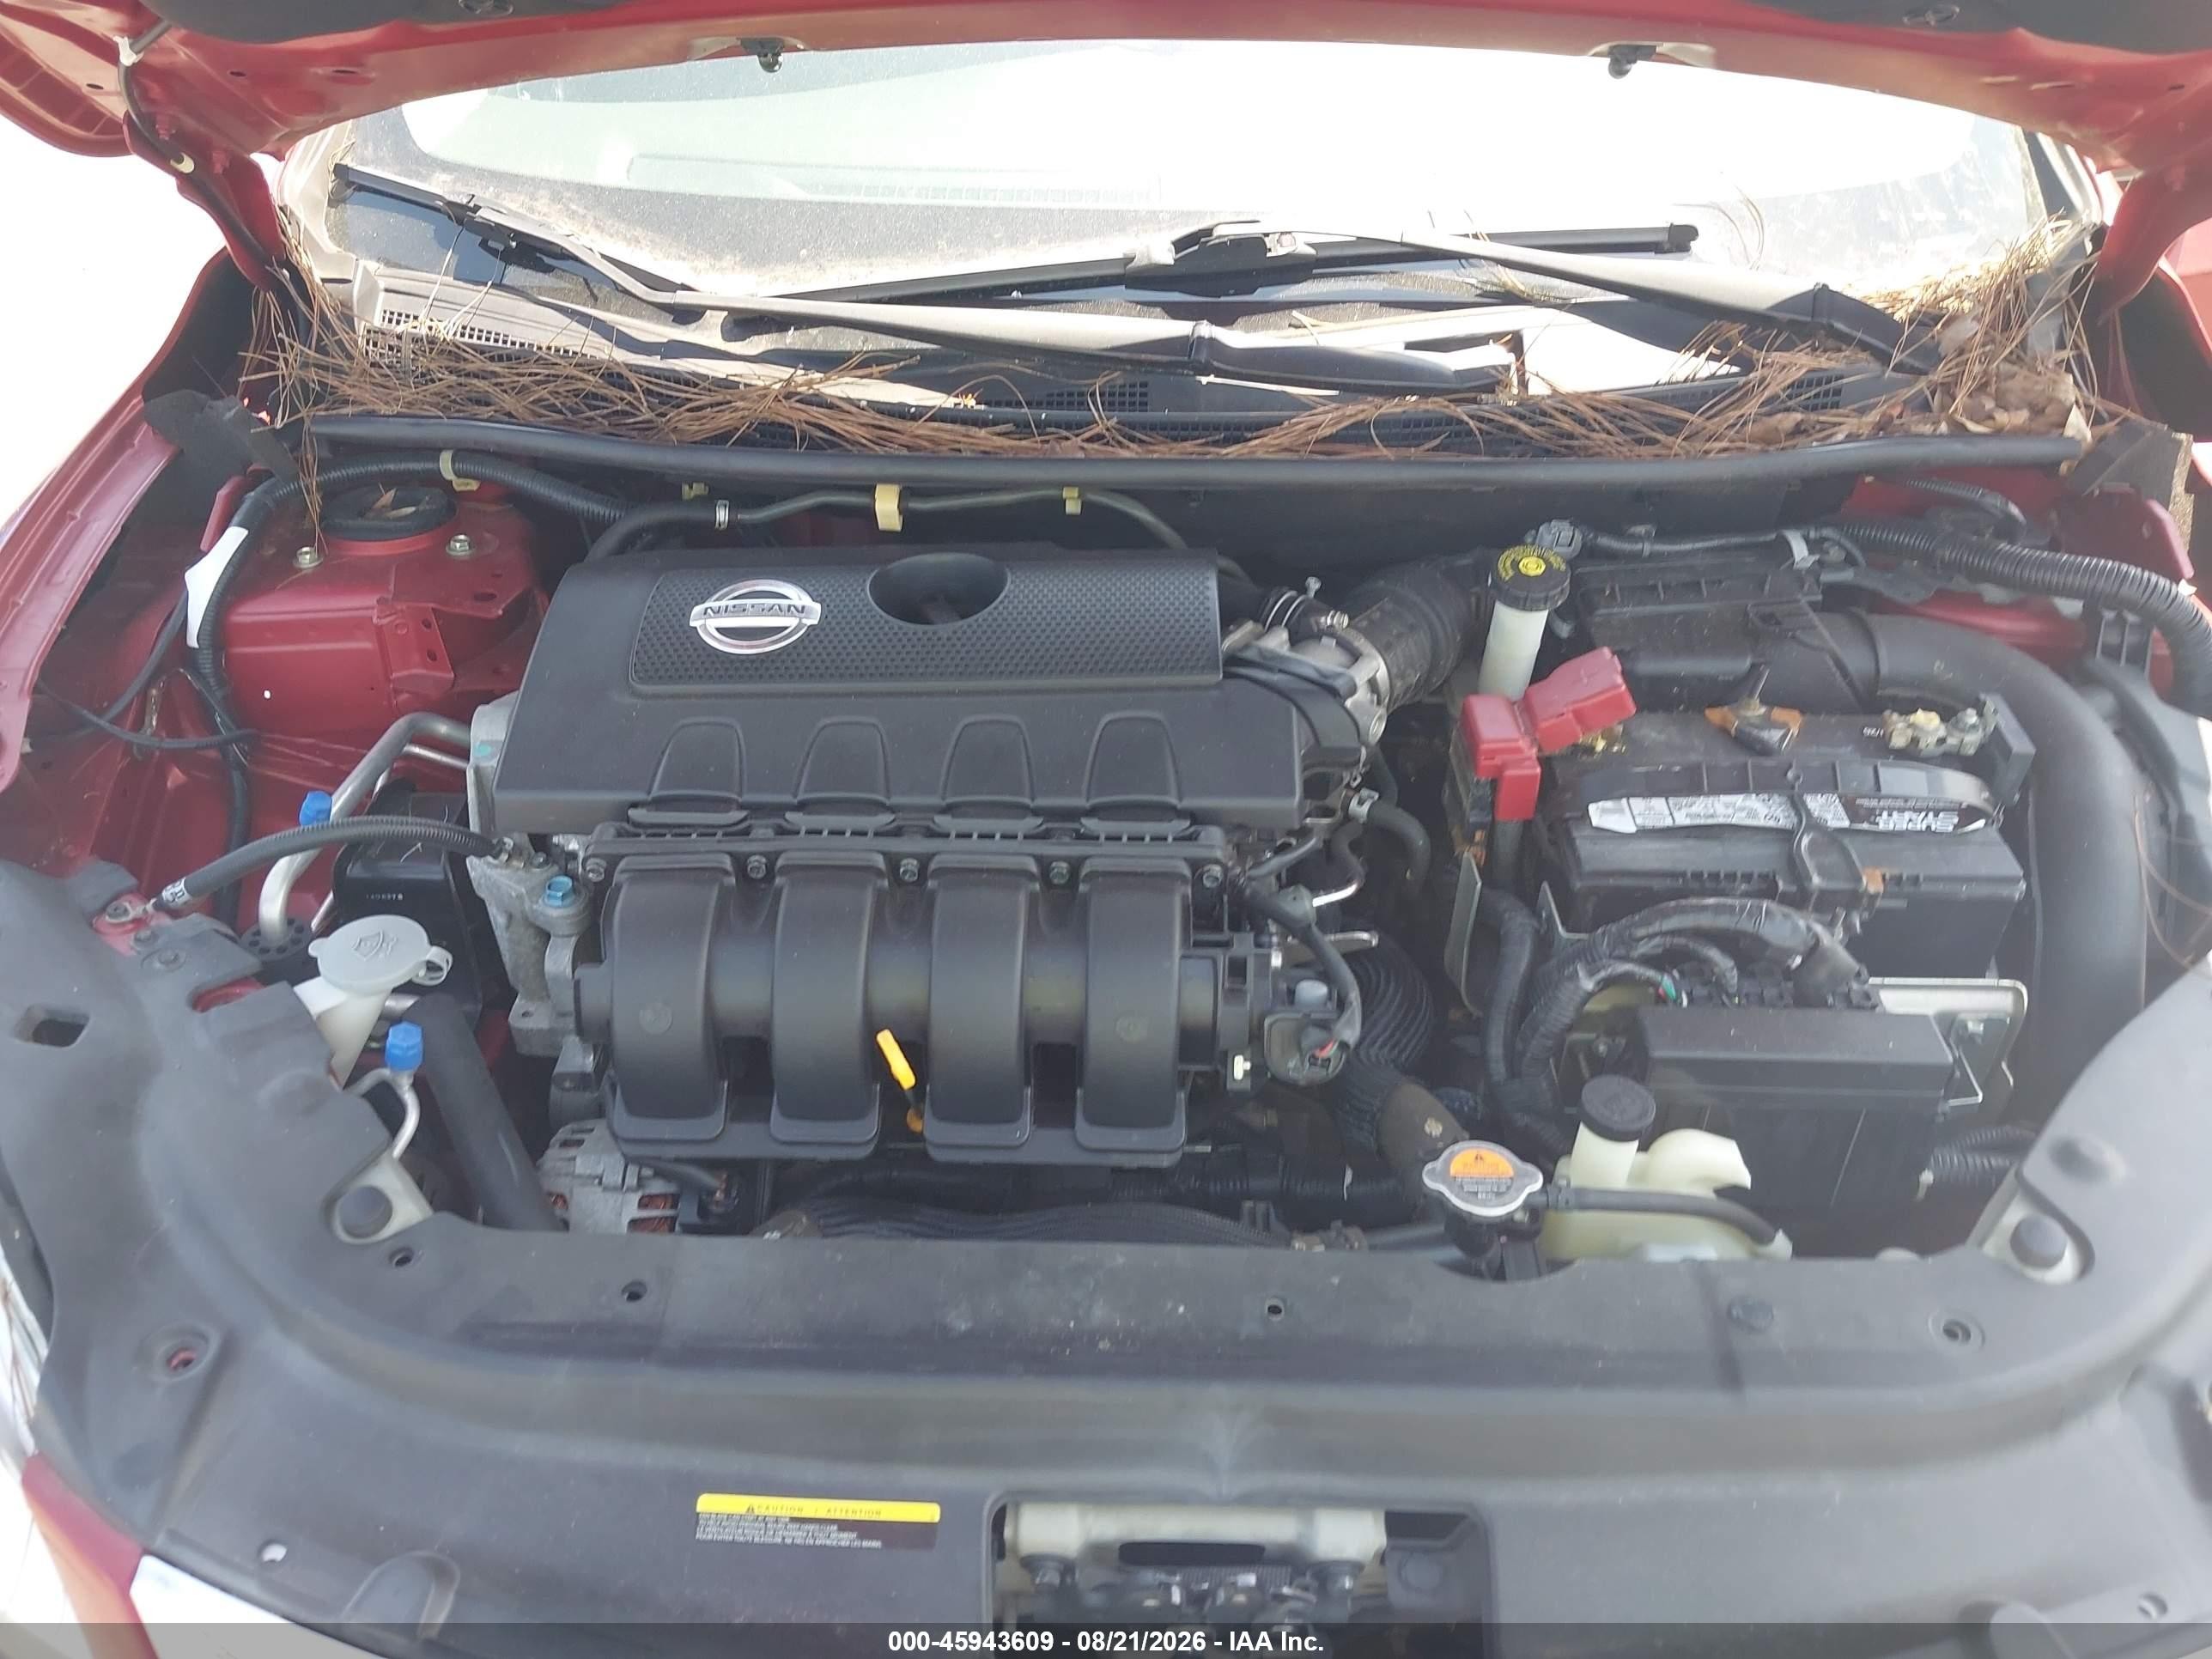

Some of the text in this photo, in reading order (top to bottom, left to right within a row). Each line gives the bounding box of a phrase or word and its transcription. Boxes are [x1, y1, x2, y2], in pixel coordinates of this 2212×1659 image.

[702, 603, 806, 617] NISSAN
[756, 1504, 804, 1516] CAUTION
[825, 1507, 883, 1519] ATTENTION
